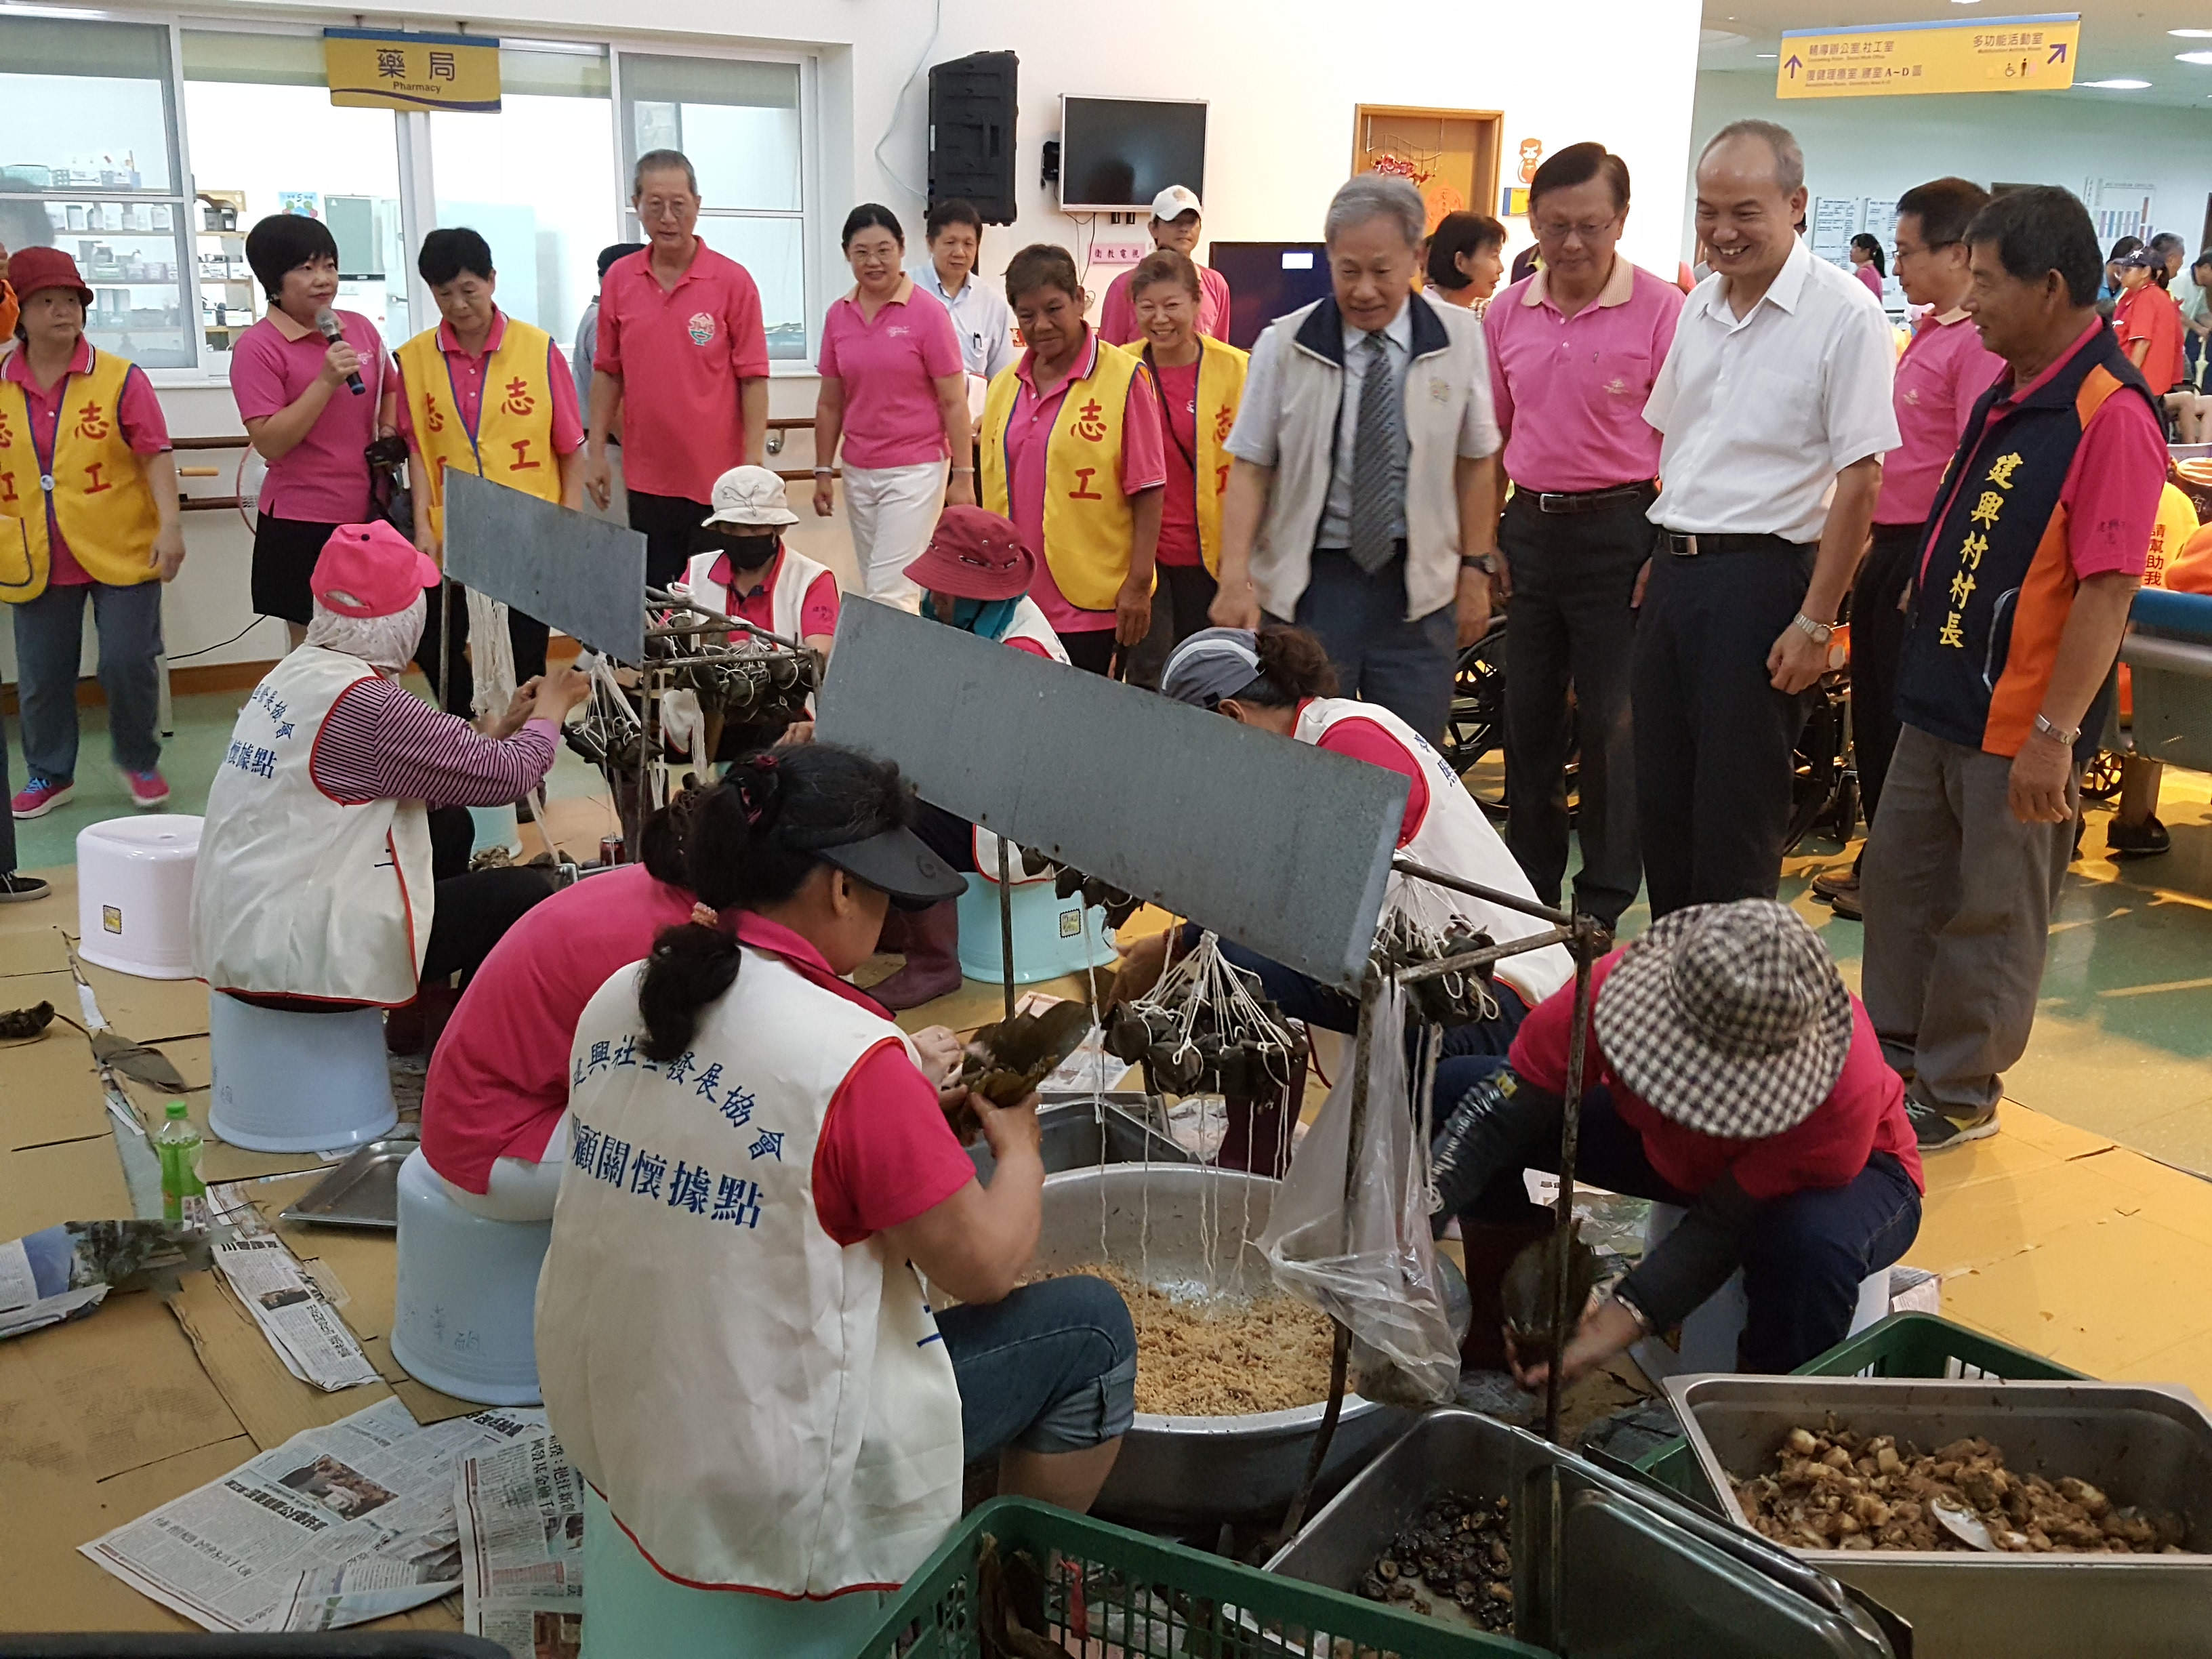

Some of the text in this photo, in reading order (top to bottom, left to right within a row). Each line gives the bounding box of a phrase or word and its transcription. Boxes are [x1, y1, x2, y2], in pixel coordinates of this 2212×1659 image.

[376, 49, 455, 81] 藥局
[393, 81, 441, 94] Pharmacy
[1973, 33, 2043, 47] 多功能活動室
[74, 400, 112, 495] 志工
[501, 376, 541, 471] 志工
[1069, 398, 1107, 500] 志工
[1940, 452, 2024, 649] 建興村村長
